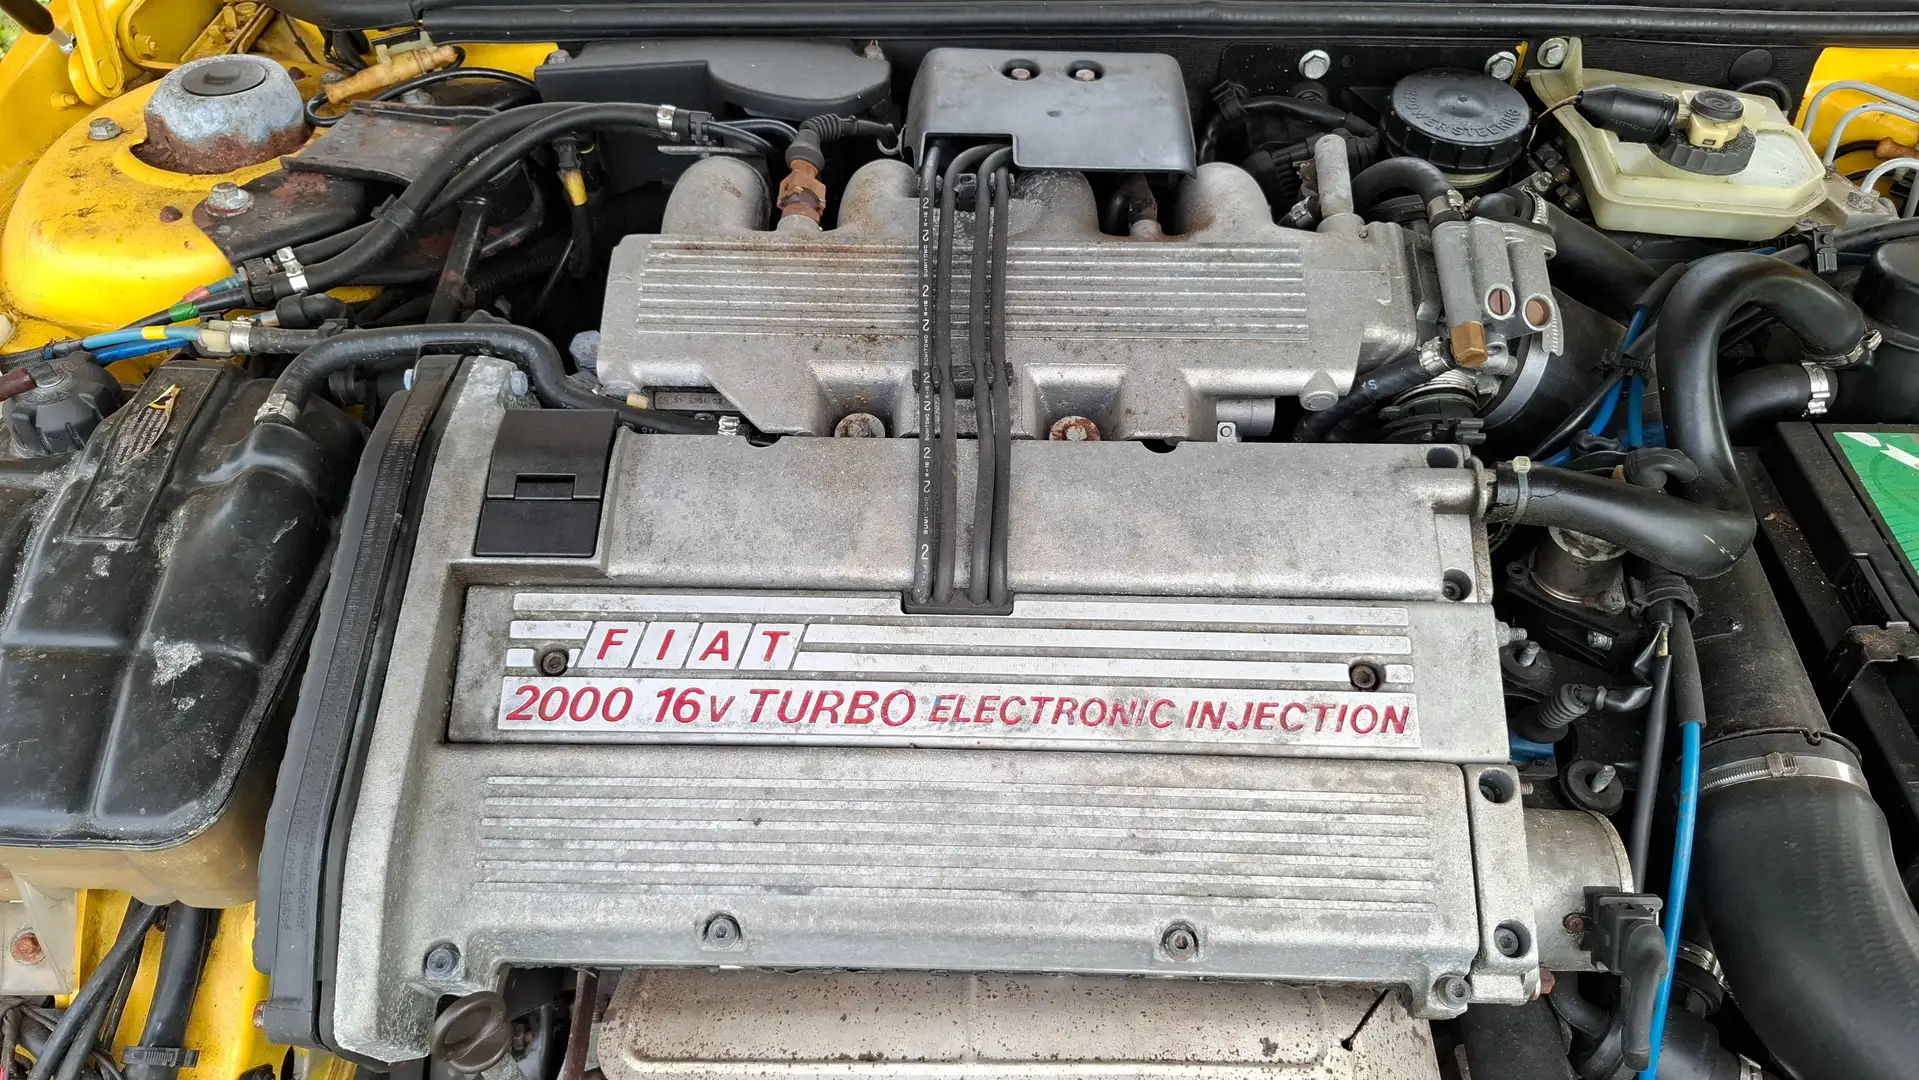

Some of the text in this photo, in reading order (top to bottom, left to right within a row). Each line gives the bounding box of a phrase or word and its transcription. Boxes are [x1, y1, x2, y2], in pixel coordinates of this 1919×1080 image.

[1403, 95, 1521, 137] POWER STEERING
[922, 197, 930, 209] 2
[922, 229, 930, 242] 2
[922, 284, 930, 297] 2
[922, 319, 930, 332] 2
[923, 372, 931, 384] 2
[923, 400, 931, 412] 2
[923, 446, 931, 459] 2
[923, 480, 931, 493] 2
[921, 543, 929, 560] 2
[597, 628, 790, 662] FIAT
[505, 684, 634, 722] 2000
[748, 687, 917, 728] TURBO
[928, 693, 1176, 728] ELECTRONIC
[1184, 699, 1410, 735] INJECTION
